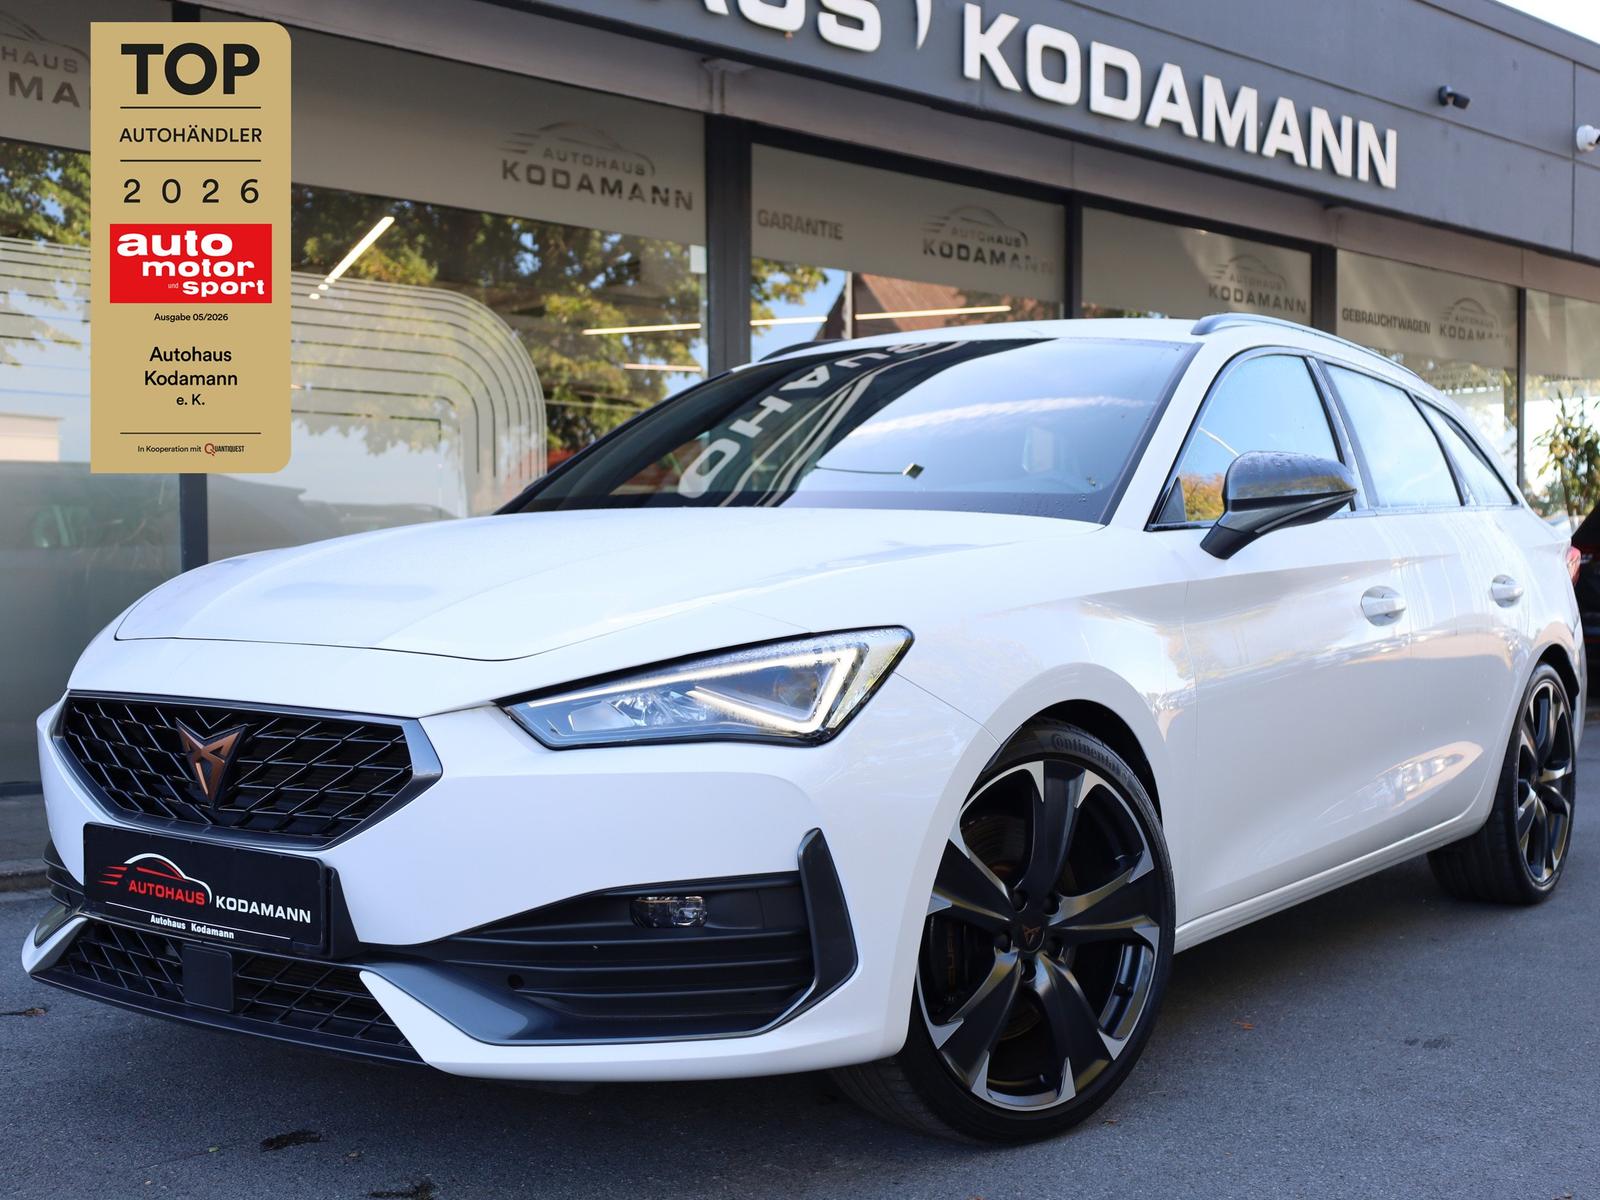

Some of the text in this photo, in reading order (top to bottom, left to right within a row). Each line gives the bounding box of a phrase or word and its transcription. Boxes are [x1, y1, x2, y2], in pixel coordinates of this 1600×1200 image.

[963, 3, 1397, 190] KODAMANN
[543, 147, 646, 176] AUTOHAUS
[502, 159, 693, 211] KODAMANN
[757, 209, 843, 240] GARANTIE
[951, 226, 1022, 248] AUTOHAUS
[1208, 283, 1307, 313] KODAMANN
[1342, 307, 1431, 334] GEBRAUCHTWAGEN
[128, 879, 312, 924] AUTOHAUS KODAMANN
[150, 914, 235, 940] Autohaus Kodamann
